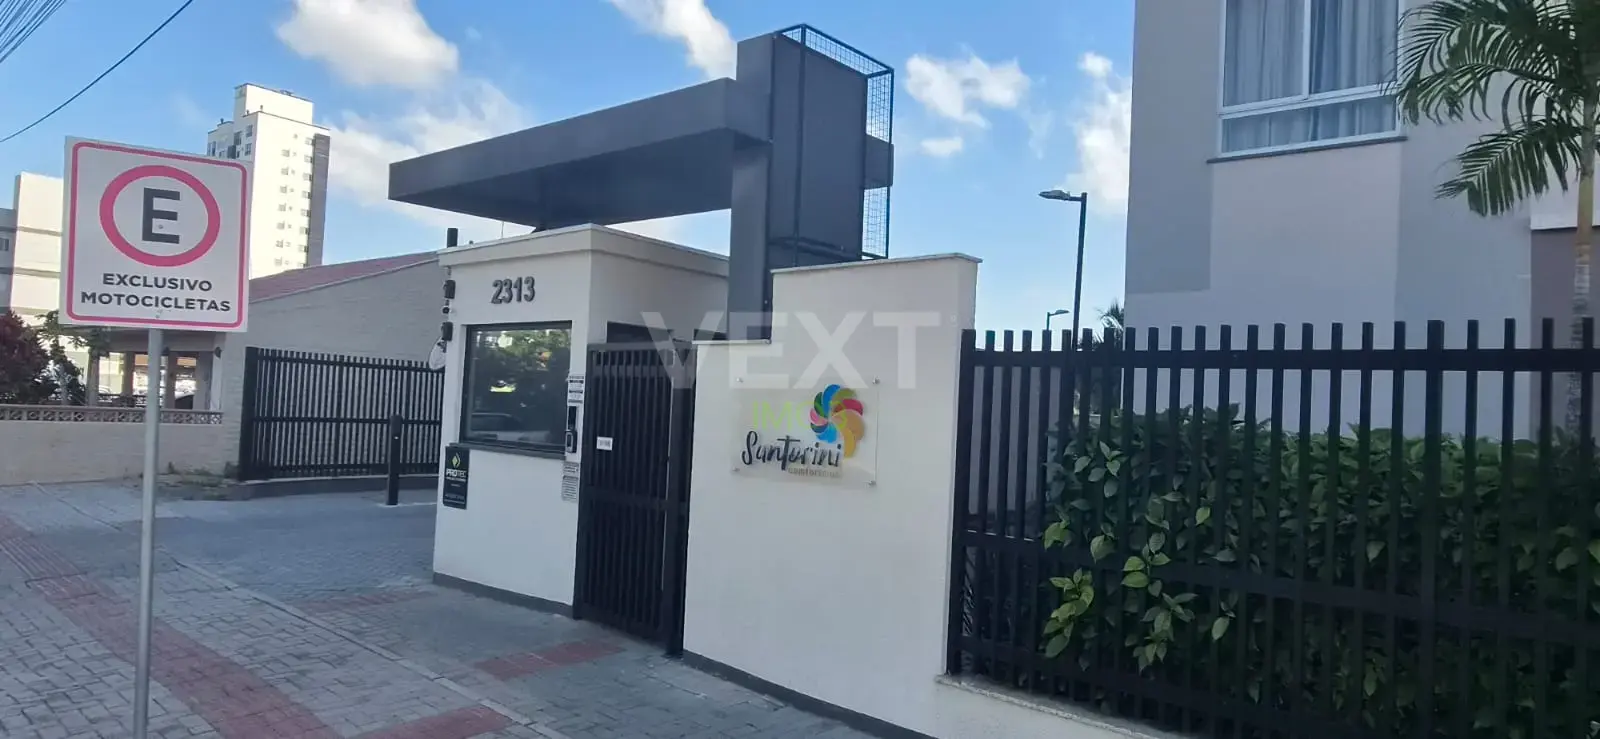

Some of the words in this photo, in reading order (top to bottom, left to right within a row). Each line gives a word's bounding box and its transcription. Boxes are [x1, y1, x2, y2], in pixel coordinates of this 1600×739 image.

[142, 187, 181, 244] E
[102, 273, 213, 292] EXCLUSIVO
[491, 276, 535, 304] 2313
[80, 291, 231, 312] MOTOCICLETAS
[446, 468, 467, 477] PROTEC
